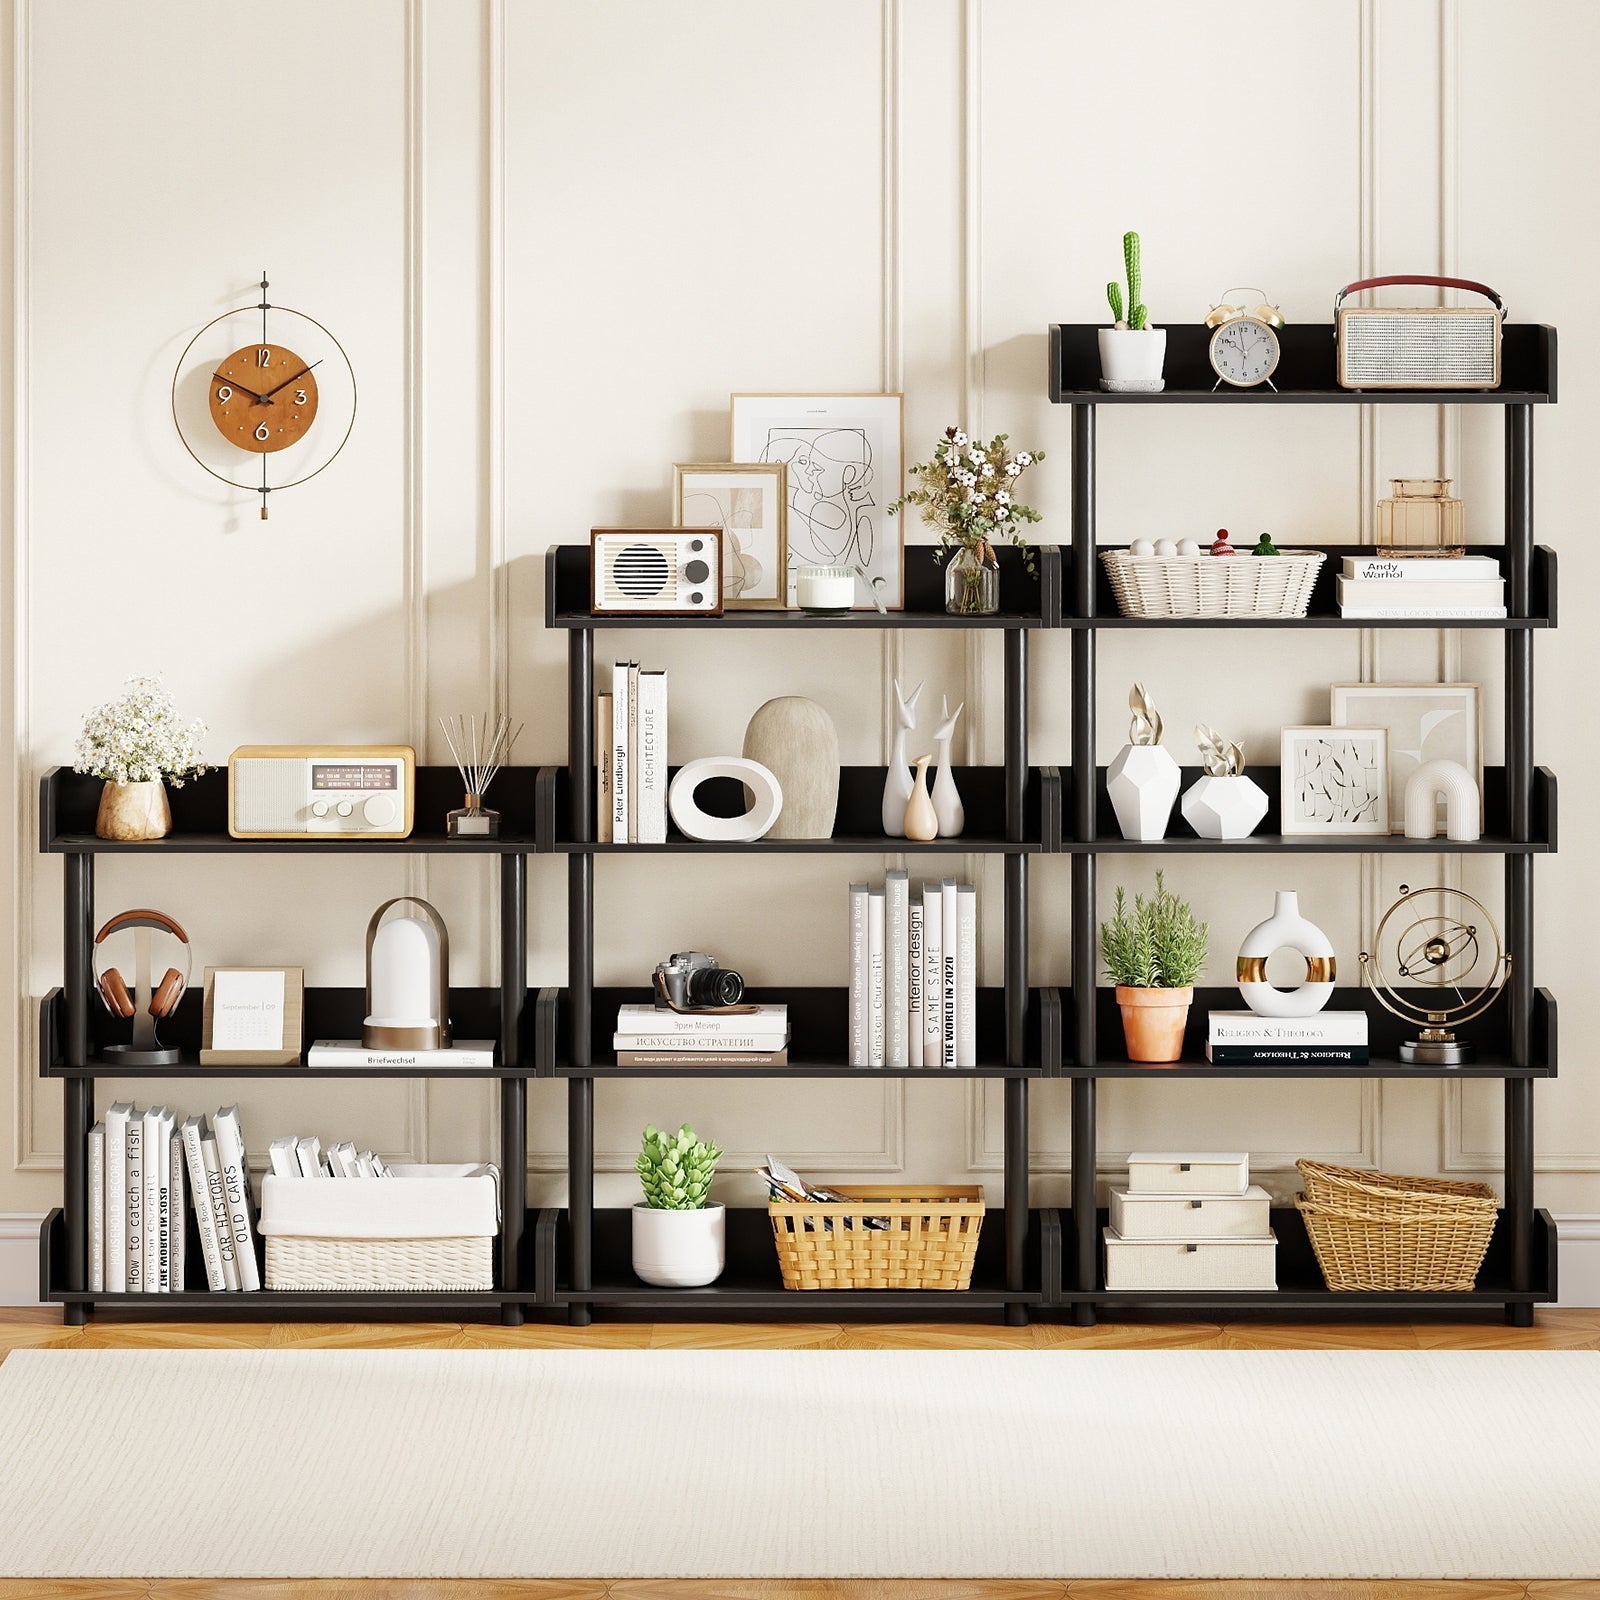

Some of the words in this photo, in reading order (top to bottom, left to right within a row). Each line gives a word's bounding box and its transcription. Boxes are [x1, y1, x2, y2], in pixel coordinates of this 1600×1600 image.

[258, 349, 270, 367] 12
[219, 386, 232, 404] 9
[295, 390, 307, 405] 3
[256, 422, 269, 440] 6
[1363, 571, 1403, 579] Warhol
[1368, 563, 1398, 572] Andy
[645, 709, 653, 790] ARCHITECTURE
[615, 745, 625, 794] Lindbergh
[615, 798, 623, 822] Peter
[893, 884, 901, 906] house
[893, 911, 901, 924] the
[893, 930, 901, 938] in
[909, 912, 922, 959] design
[961, 917, 971, 975] DECORATES
[854, 932, 863, 963] Hawking
[894, 943, 903, 992] arrangement
[928, 946, 939, 984] SAME
[945, 957, 954, 984] 2020
[854, 967, 863, 998] Stephen
[873, 952, 882, 1009] Churchill
[909, 963, 920, 1012] Interior
[945, 986, 954, 999] IN
[895, 997, 901, 1007] an
[928, 995, 939, 1033] SAME
[962, 983, 971, 1041] HOUSEHOLD
[674, 1022, 694, 1030] Эрин
[893, 1011, 901, 1029] make
[945, 1002, 954, 1041] WORLD
[637, 1038, 695, 1046] ИСКУССТВО
[873, 1016, 882, 1061] Winston
[894, 1034, 901, 1042] to
[1264, 1029, 1271, 1037] &
[945, 1044, 954, 1063] THE
[128, 1129, 139, 1160] fish
[187, 1131, 201, 1173] children
[110, 1138, 120, 1198] DECORATES
[196, 1180, 205, 1195] for
[224, 1165, 240, 1203] CARS
[128, 1186, 139, 1227] catch
[147, 1174, 155, 1232] Churchill
[199, 1200, 209, 1222] Book
[208, 1170, 228, 1228] HISTORY
[95, 1232, 99, 1240] an
[111, 1205, 120, 1264] HOUSEHOLD
[173, 1223, 180, 1232] by
[204, 1227, 213, 1249] DRAW
[232, 1214, 248, 1243] OLD
[129, 1236, 139, 1251] to
[220, 1232, 234, 1261] CAR
[94, 1262, 99, 1270] to
[209, 1254, 215, 1265] TO
[129, 1260, 139, 1285] How
[211, 1270, 220, 1287] HOW
